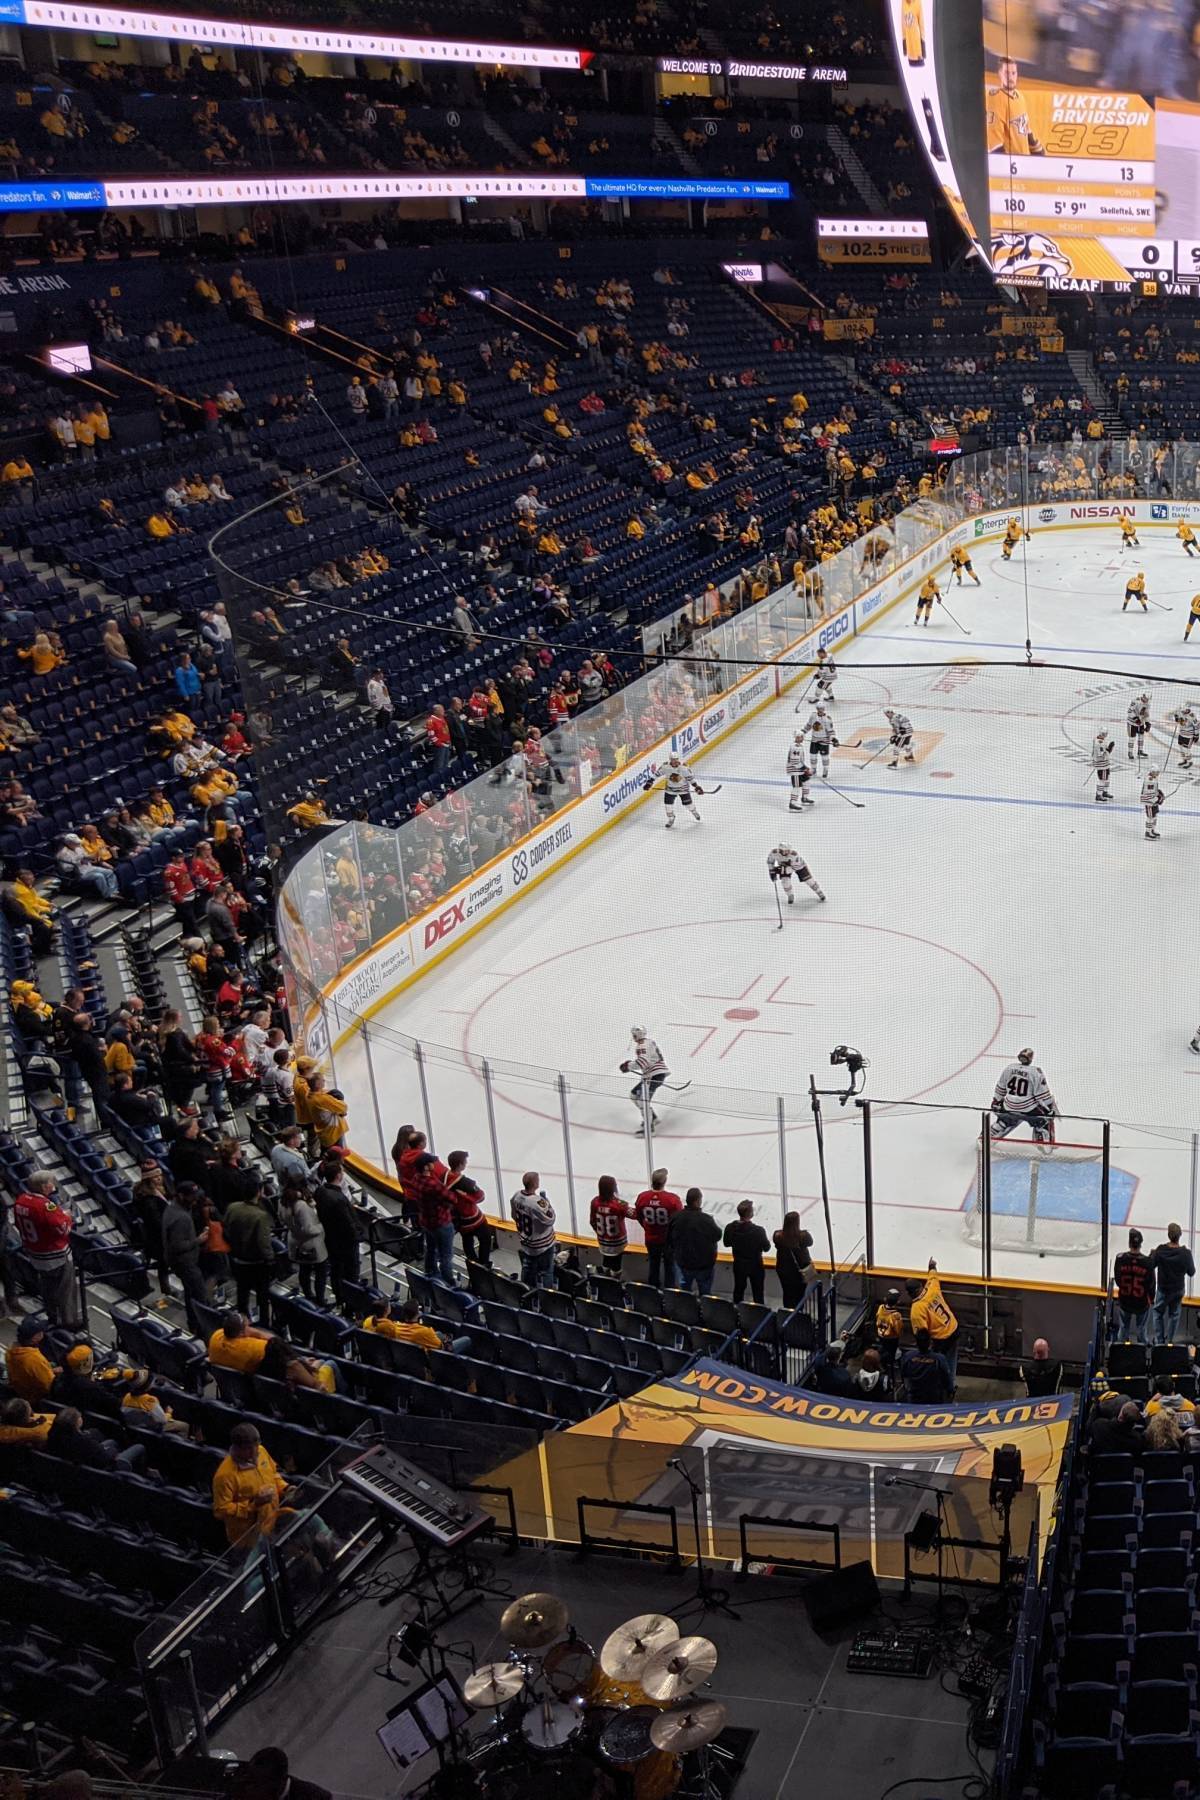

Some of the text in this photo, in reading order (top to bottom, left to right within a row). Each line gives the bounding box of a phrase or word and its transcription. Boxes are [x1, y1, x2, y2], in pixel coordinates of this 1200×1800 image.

[663, 60, 847, 81] WELCOME TO BRIDGESTONE ARENA
[1052, 94, 1129, 110] VIKTOR
[1052, 109, 1150, 126] ARVIDSSON
[1046, 123, 1130, 156] 33
[1010, 162, 1134, 181] 6 7 13
[67, 190, 92, 200] Walmart
[591, 183, 738, 195] The ultimate HQ for every Nashville Predators fan.
[755, 186, 777, 194] Walmart
[1004, 198, 1026, 212] 180
[1136, 208, 1151, 217] SWE
[842, 242, 888, 256] 102.5
[1142, 245, 1160, 265] 0
[18, 273, 71, 293] ARENA
[995, 279, 1044, 288] PREDATORS
[1159, 271, 1168, 281] 0
[1049, 279, 1100, 292] NCAAF
[1114, 282, 1132, 293] UK
[1145, 285, 1156, 294] 38
[1164, 284, 1191, 296] VAN
[1070, 506, 1136, 518] NISSAN
[1171, 505, 1191, 513] FIFTH
[818, 613, 849, 648] GEICO
[603, 765, 651, 814] Southwest
[529, 821, 573, 867] COOPER STEEL
[469, 873, 502, 903] imaging
[474, 884, 503, 914] mailing
[424, 899, 467, 950] DEX
[350, 976, 379, 1000] CAPITAL
[1007, 1076, 1029, 1097] 40
[643, 1207, 669, 1225] 88
[1120, 1276, 1145, 1297] 55
[935, 1303, 951, 1325] 3
[680, 1369, 1061, 1429] BUYFORDNOW.COM
